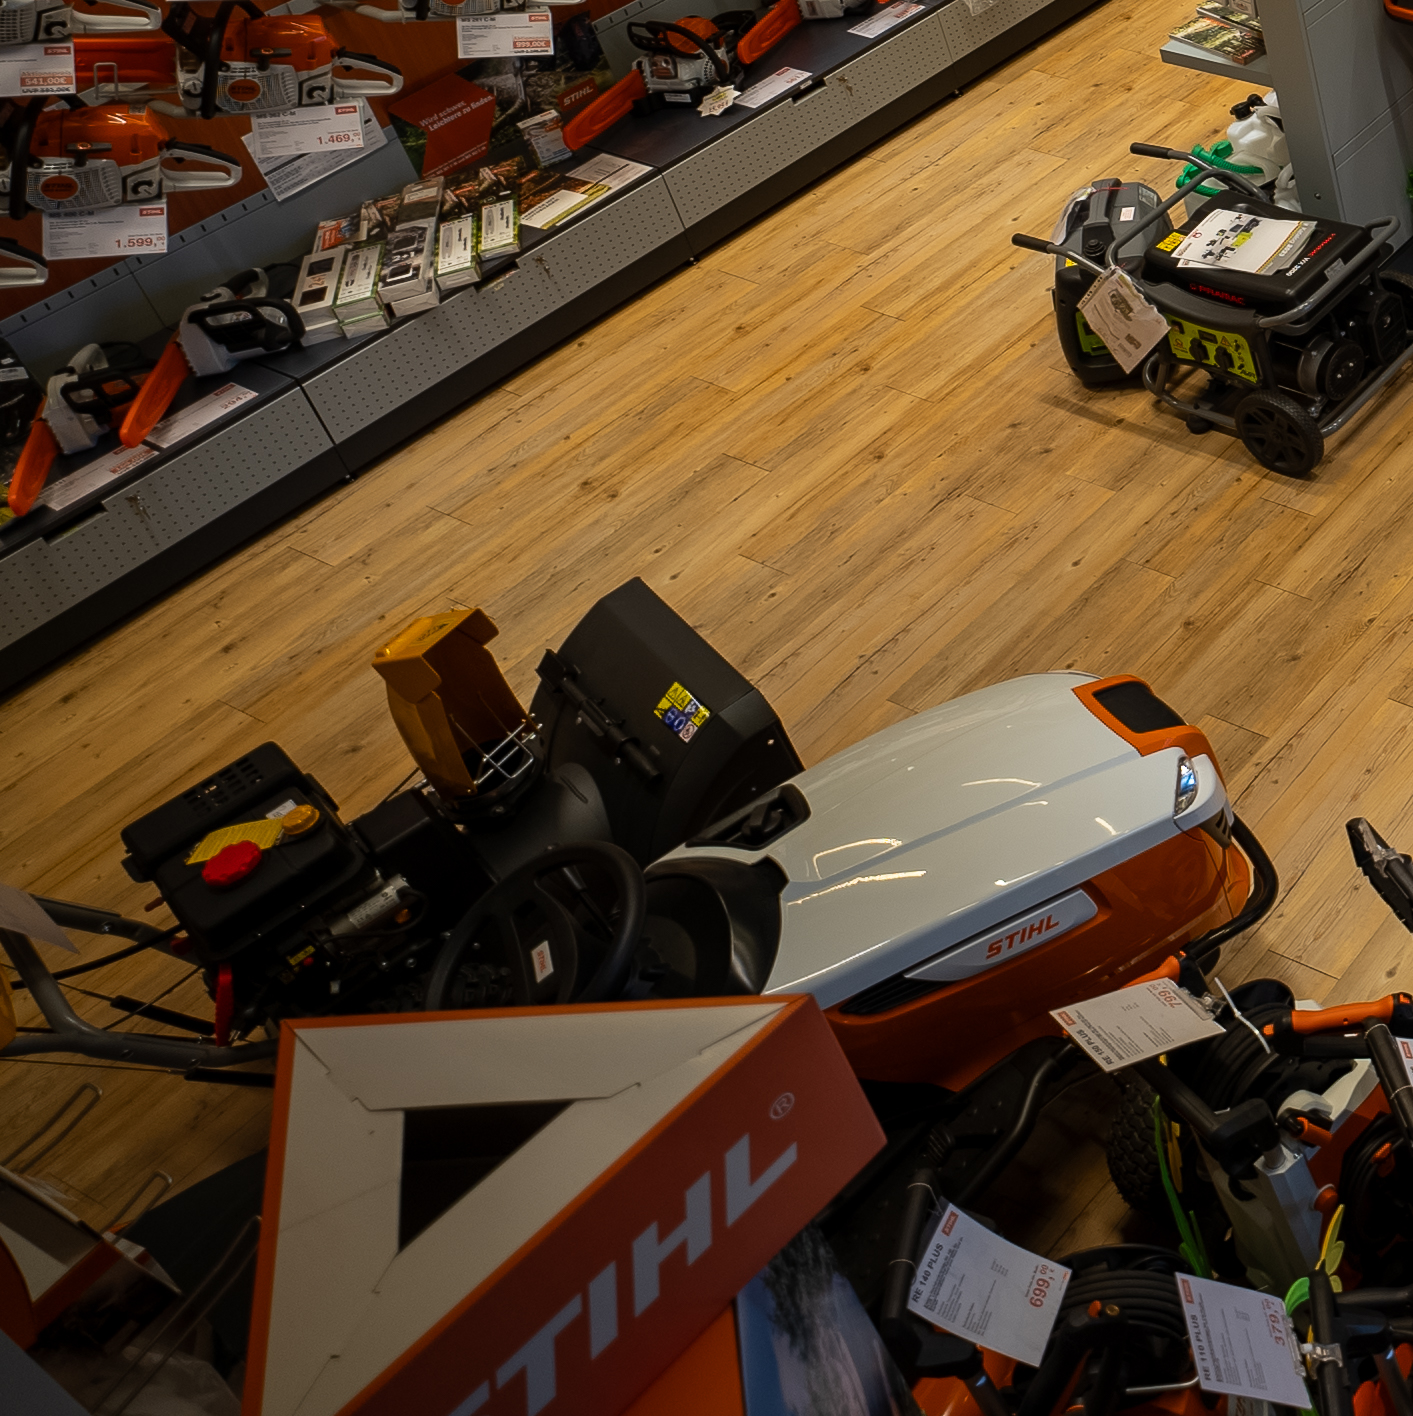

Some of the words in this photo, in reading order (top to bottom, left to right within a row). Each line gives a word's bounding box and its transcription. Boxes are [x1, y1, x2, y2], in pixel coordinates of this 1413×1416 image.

[563, 85, 594, 107] STIHL
[986, 915, 1060, 960] STIHL
[450, 1131, 798, 1416] TIHL
